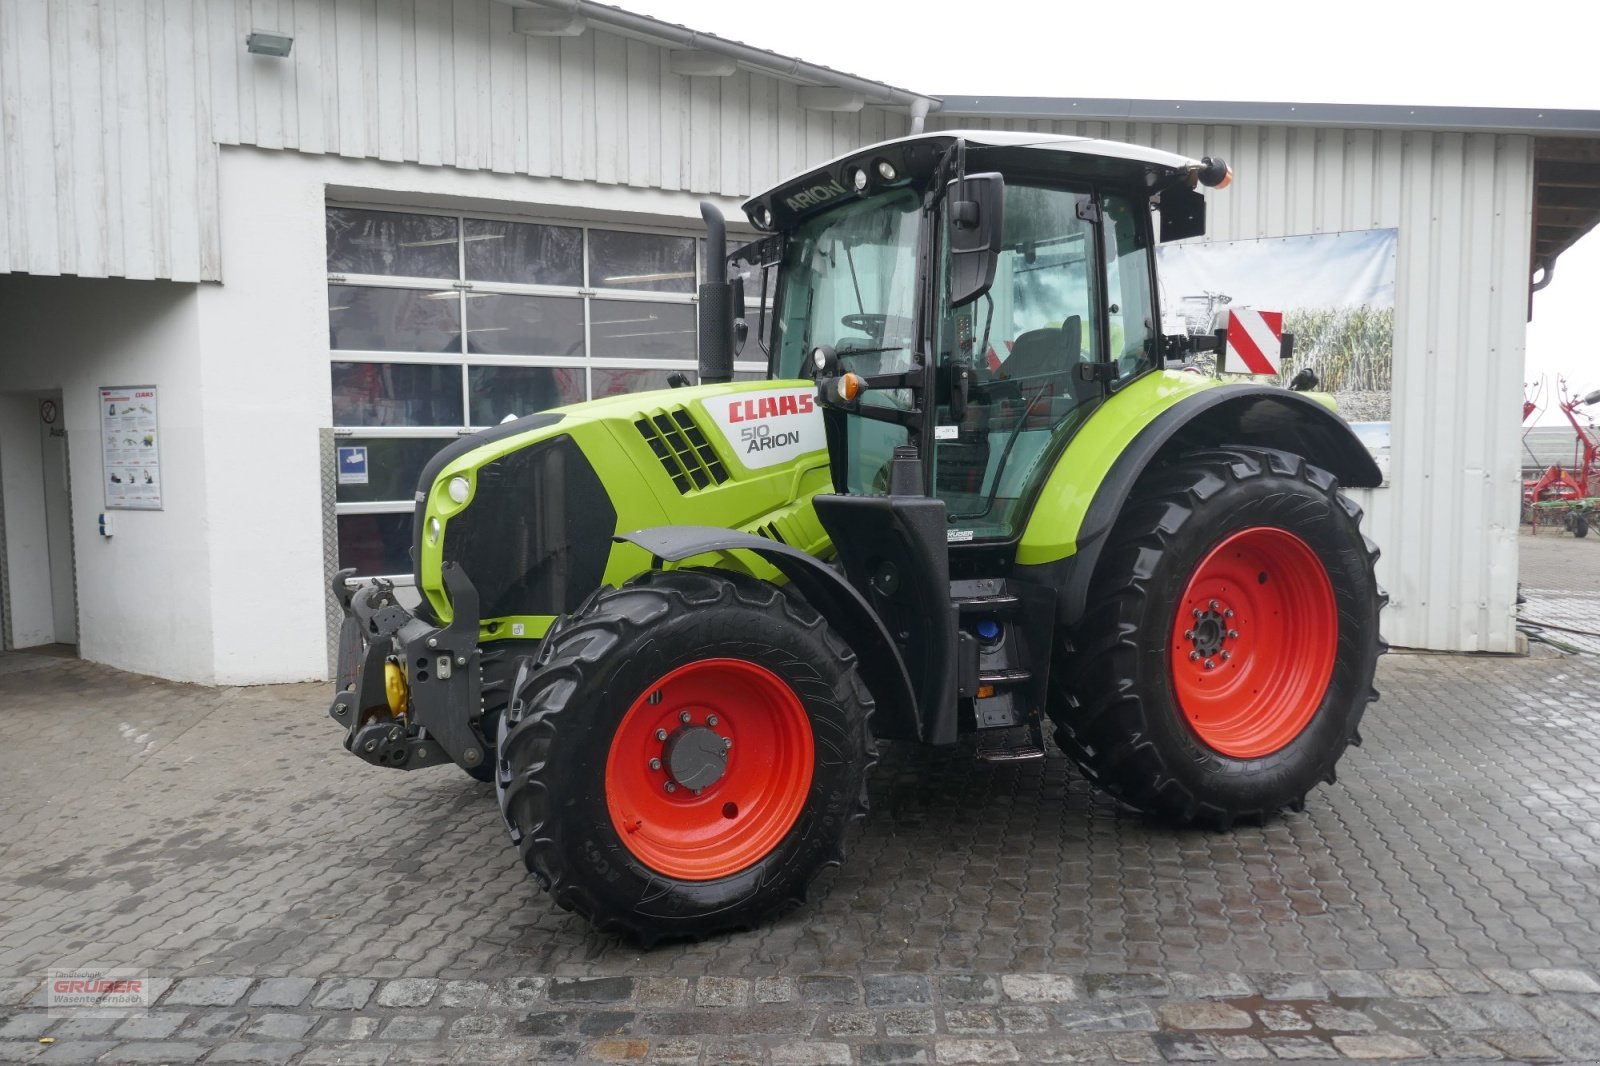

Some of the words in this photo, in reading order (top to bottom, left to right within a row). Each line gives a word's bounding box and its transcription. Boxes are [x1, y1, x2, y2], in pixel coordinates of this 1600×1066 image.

[787, 179, 847, 212] ARION
[729, 393, 814, 424] CLAAS
[741, 424, 770, 442] 510
[747, 430, 800, 454] ARION
